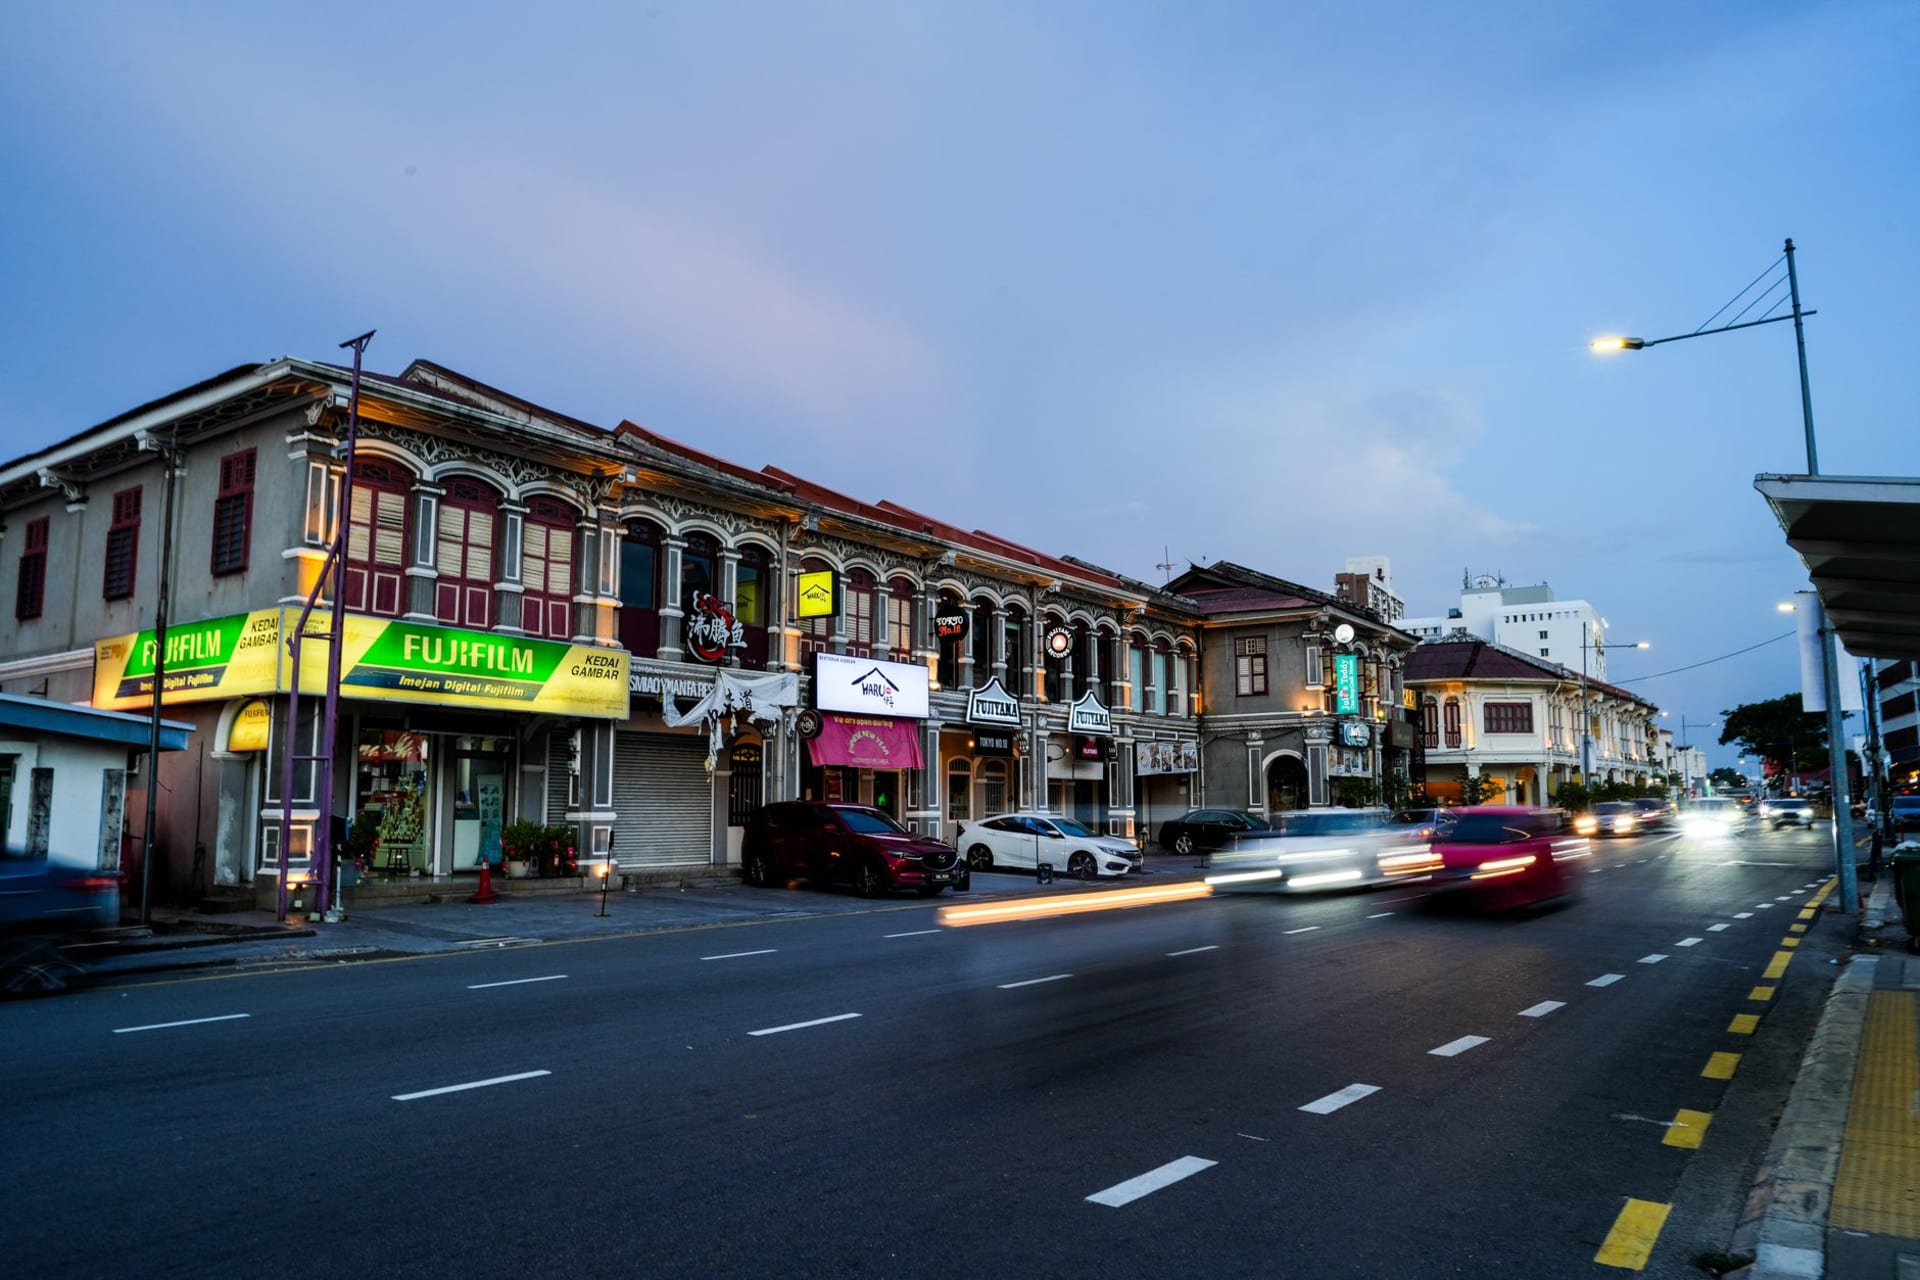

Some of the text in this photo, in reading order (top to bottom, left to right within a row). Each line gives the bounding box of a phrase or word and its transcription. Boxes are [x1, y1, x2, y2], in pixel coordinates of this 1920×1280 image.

[251, 617, 279, 633] KEDAI
[936, 615, 964, 626] TOKYO
[239, 632, 279, 649] GAMBAR
[1047, 627, 1072, 640] FUJIYAMA
[403, 634, 533, 674] FUJIFILM
[1047, 647, 1071, 659] RECORDS
[585, 654, 619, 668] KEDAI
[571, 665, 619, 681] GAMBAR
[1340, 660, 1349, 685] Teddy
[163, 676, 186, 690] Digital
[187, 673, 214, 688] Fujifilm
[399, 675, 524, 697] Imejan Digital Fujifilm
[861, 682, 886, 697] HARU
[975, 699, 1018, 718] FUJIYAMA
[857, 718, 873, 727] open
[1076, 711, 1108, 726] FUJIYAMA
[979, 736, 995, 748] TOKYO
